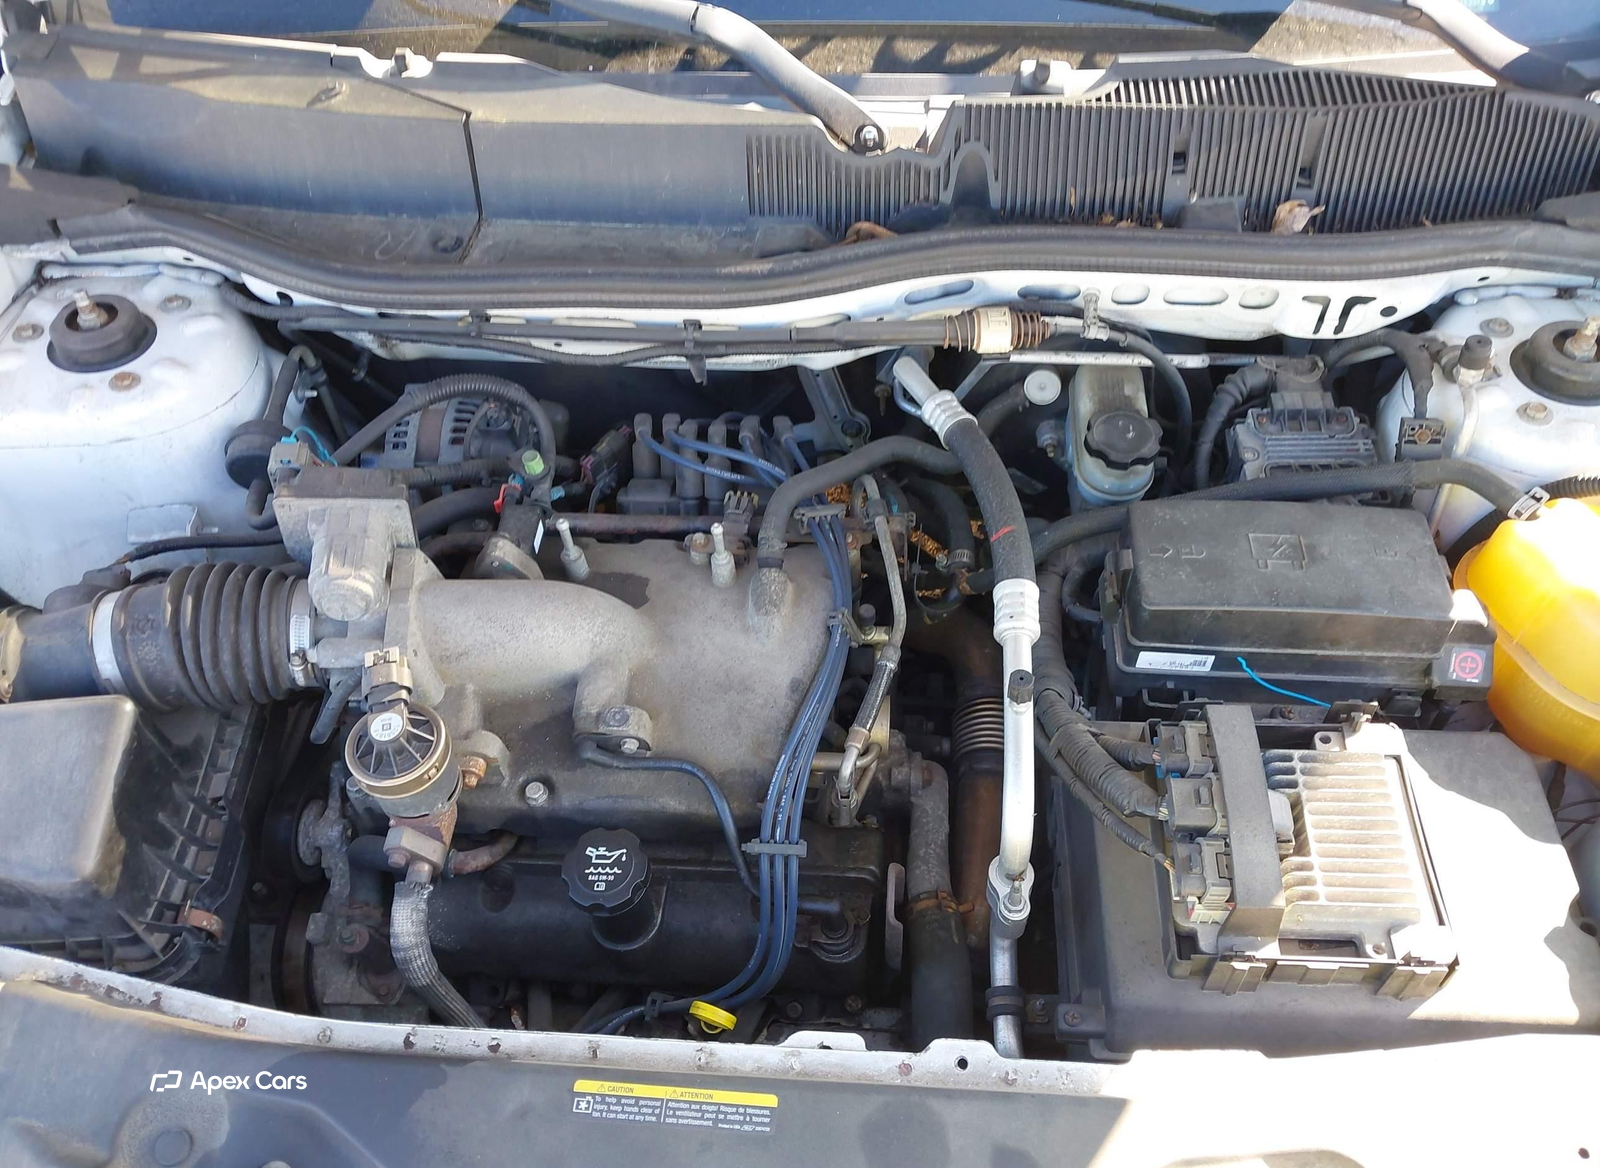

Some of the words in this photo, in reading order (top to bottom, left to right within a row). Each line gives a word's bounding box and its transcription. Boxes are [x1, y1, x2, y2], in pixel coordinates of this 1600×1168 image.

[608, 1085, 634, 1094] CAUTION
[680, 1091, 714, 1100] ATTENTION
[746, 1107, 771, 1116] blessures.
